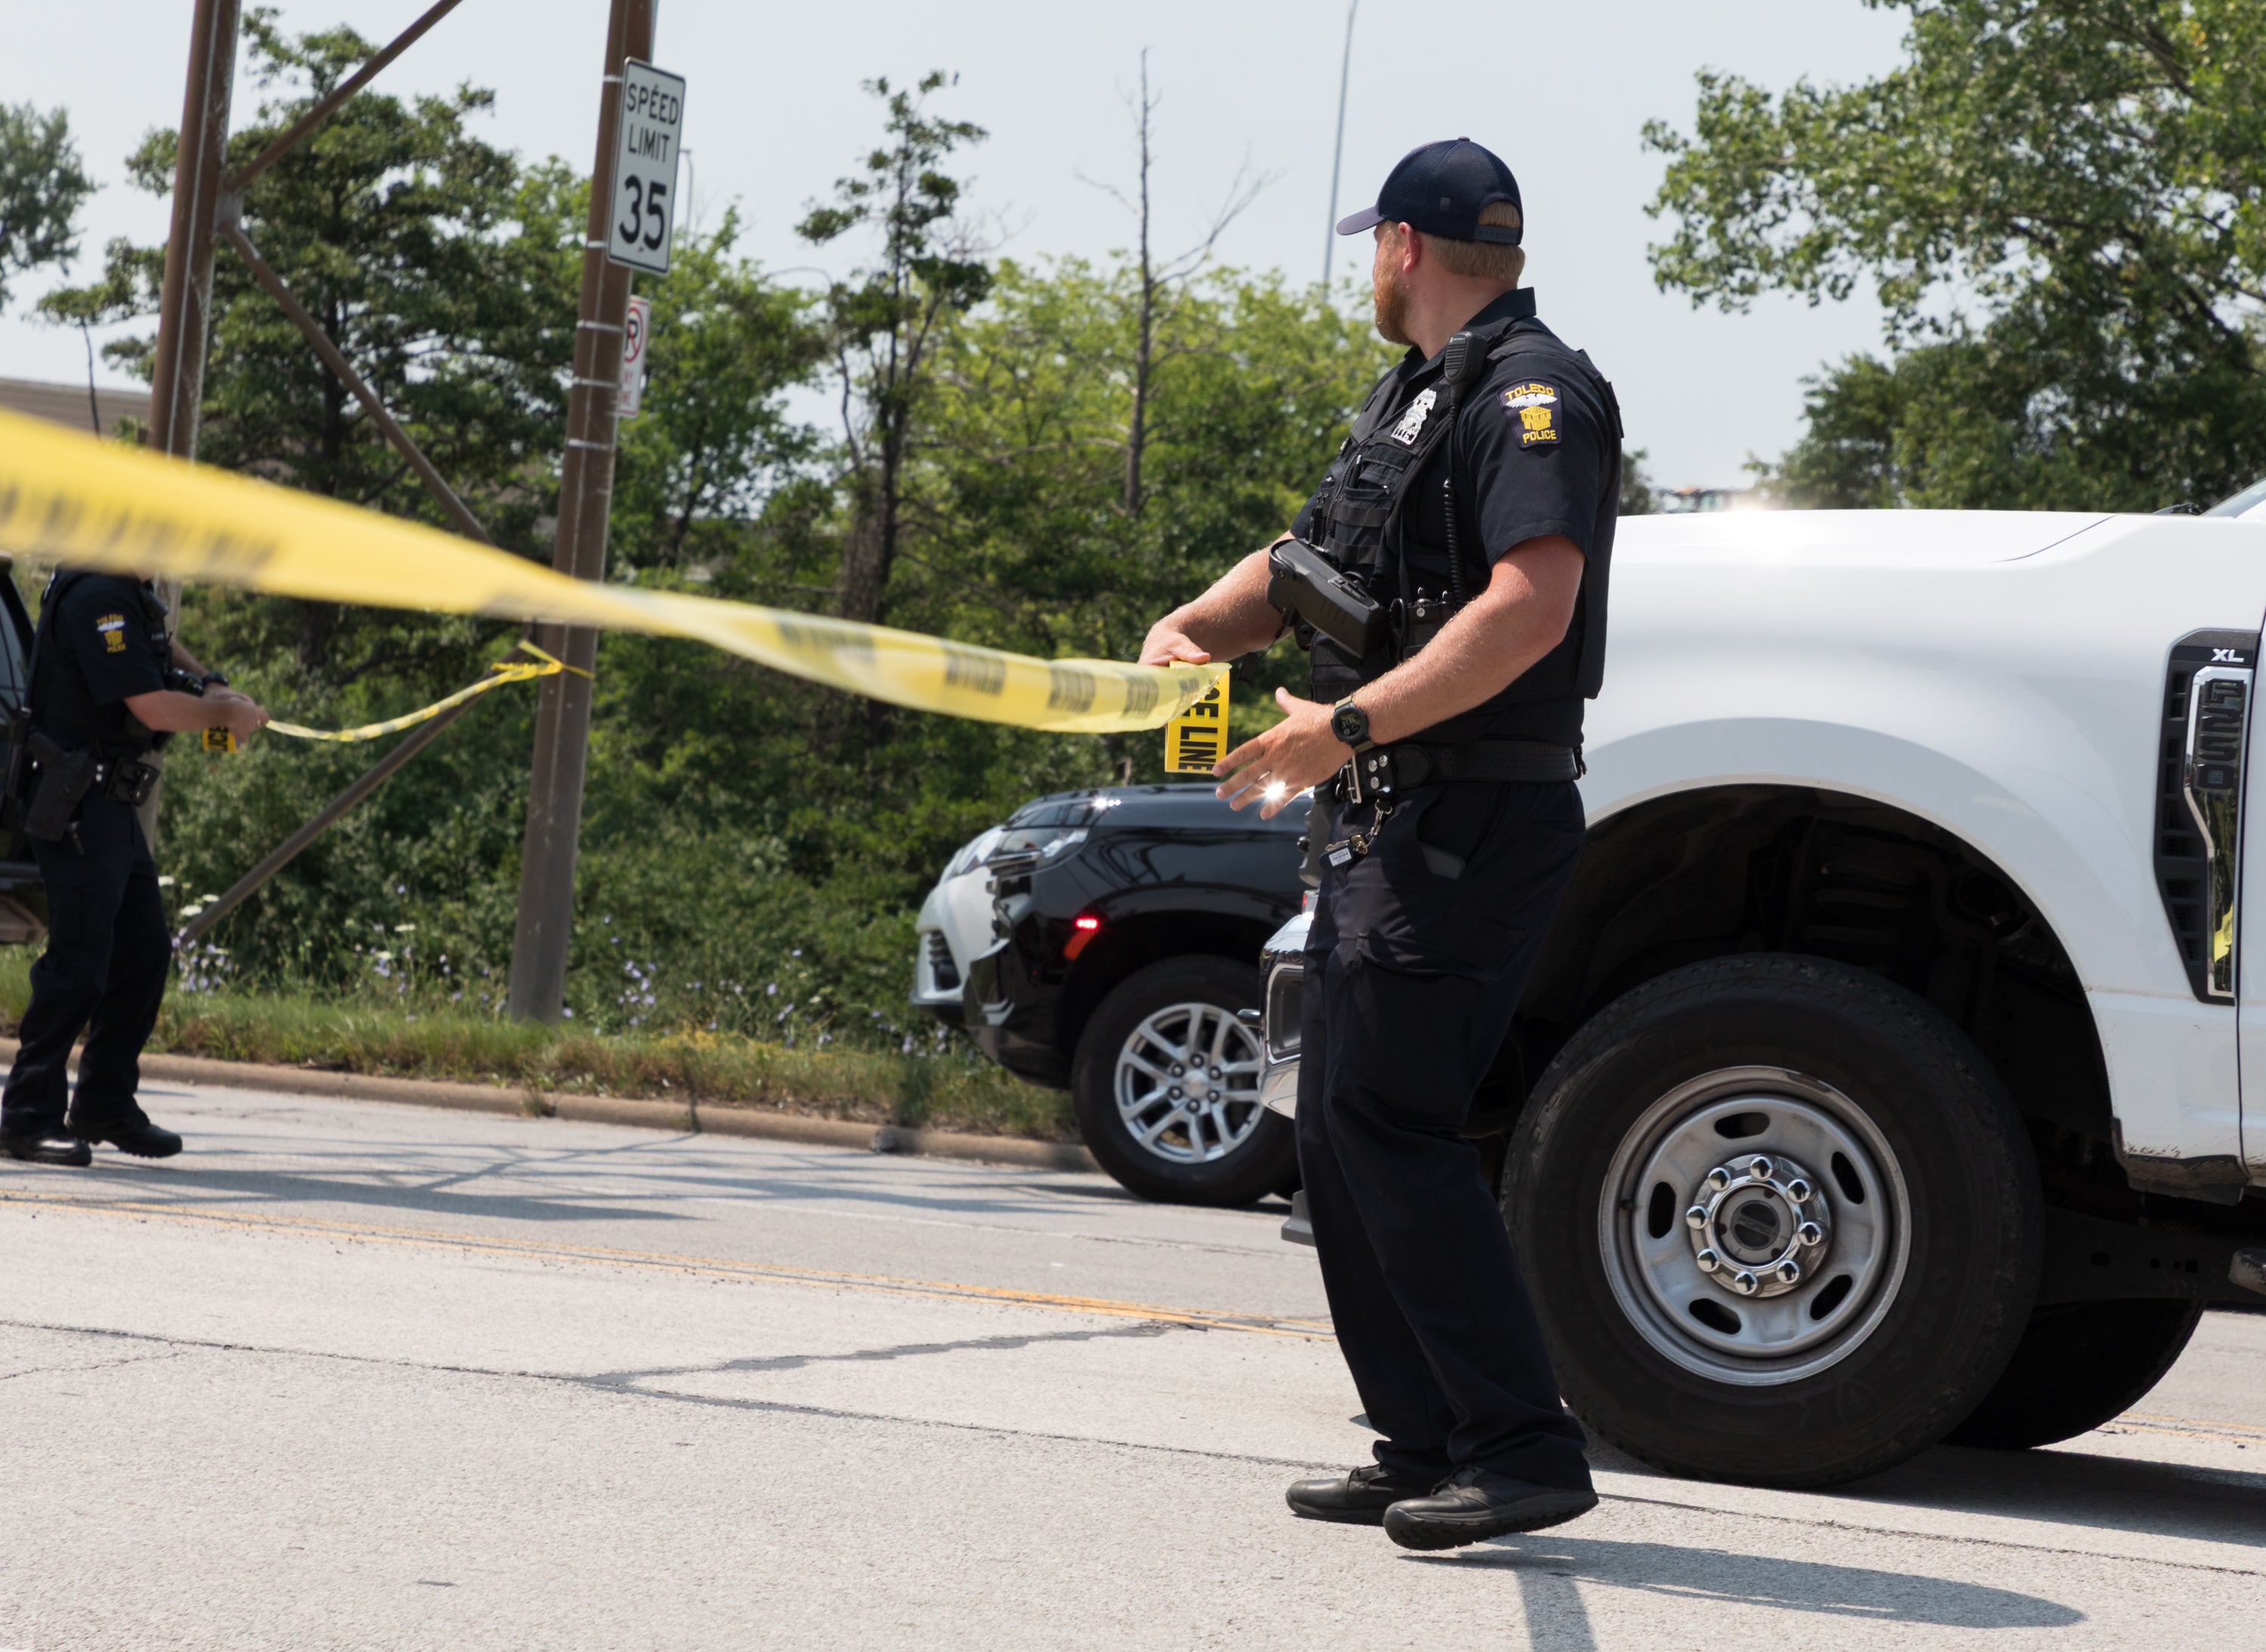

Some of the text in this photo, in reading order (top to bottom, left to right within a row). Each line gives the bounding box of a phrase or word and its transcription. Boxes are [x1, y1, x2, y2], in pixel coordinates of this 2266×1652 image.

[626, 82, 679, 126] SPEED
[628, 123, 671, 163] LIMIT
[619, 174, 667, 251] 35
[1505, 383, 1555, 400] TOLEDO
[1522, 429, 1557, 444] POLICE
[2210, 648, 2245, 663] XL
[1178, 725, 1218, 771] LINE
